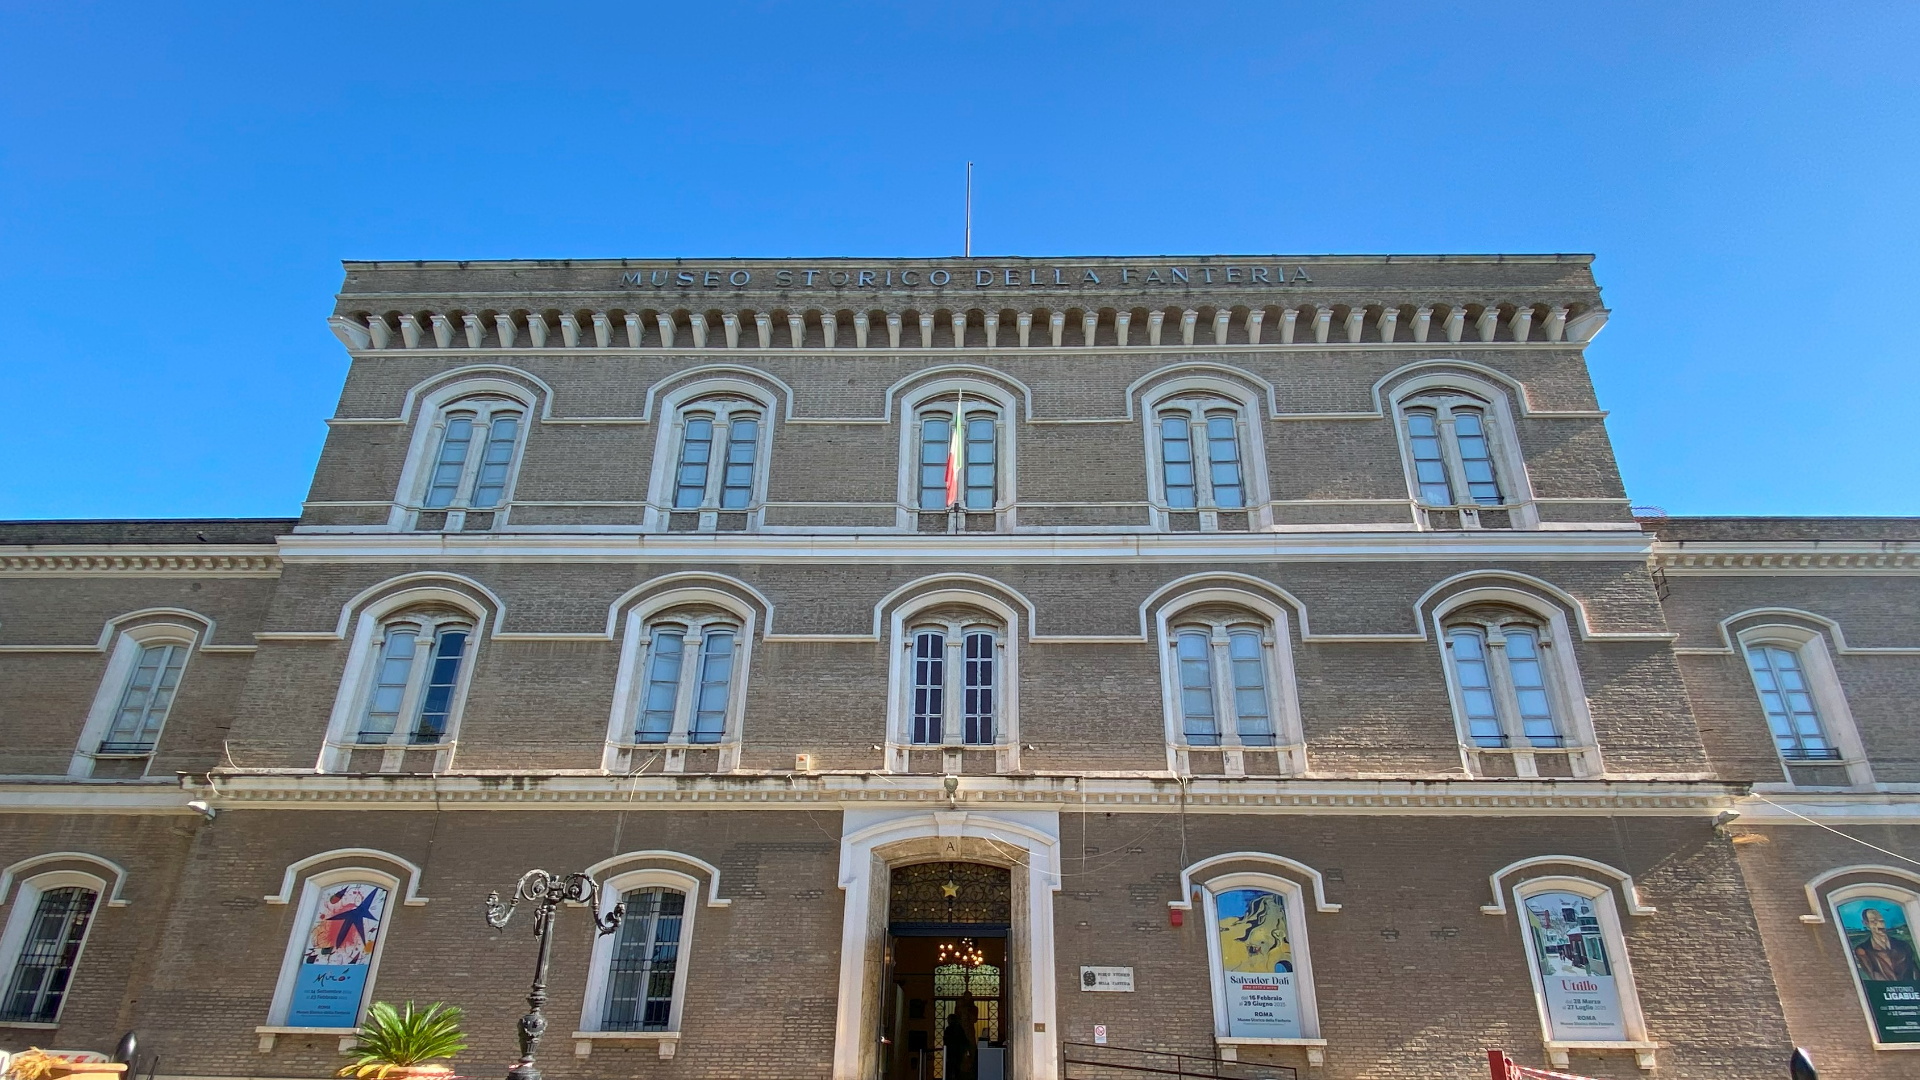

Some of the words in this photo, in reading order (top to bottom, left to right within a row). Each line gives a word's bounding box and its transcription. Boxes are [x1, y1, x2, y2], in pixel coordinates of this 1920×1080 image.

[619, 269, 751, 288] MUSEO
[775, 269, 952, 288] STORICO
[975, 268, 1101, 287] DELLA
[1120, 266, 1313, 285] FANTERIA
[946, 841, 955, 852] A
[1230, 975, 1270, 985] Salvador
[1562, 980, 1597, 991] Utrillo
